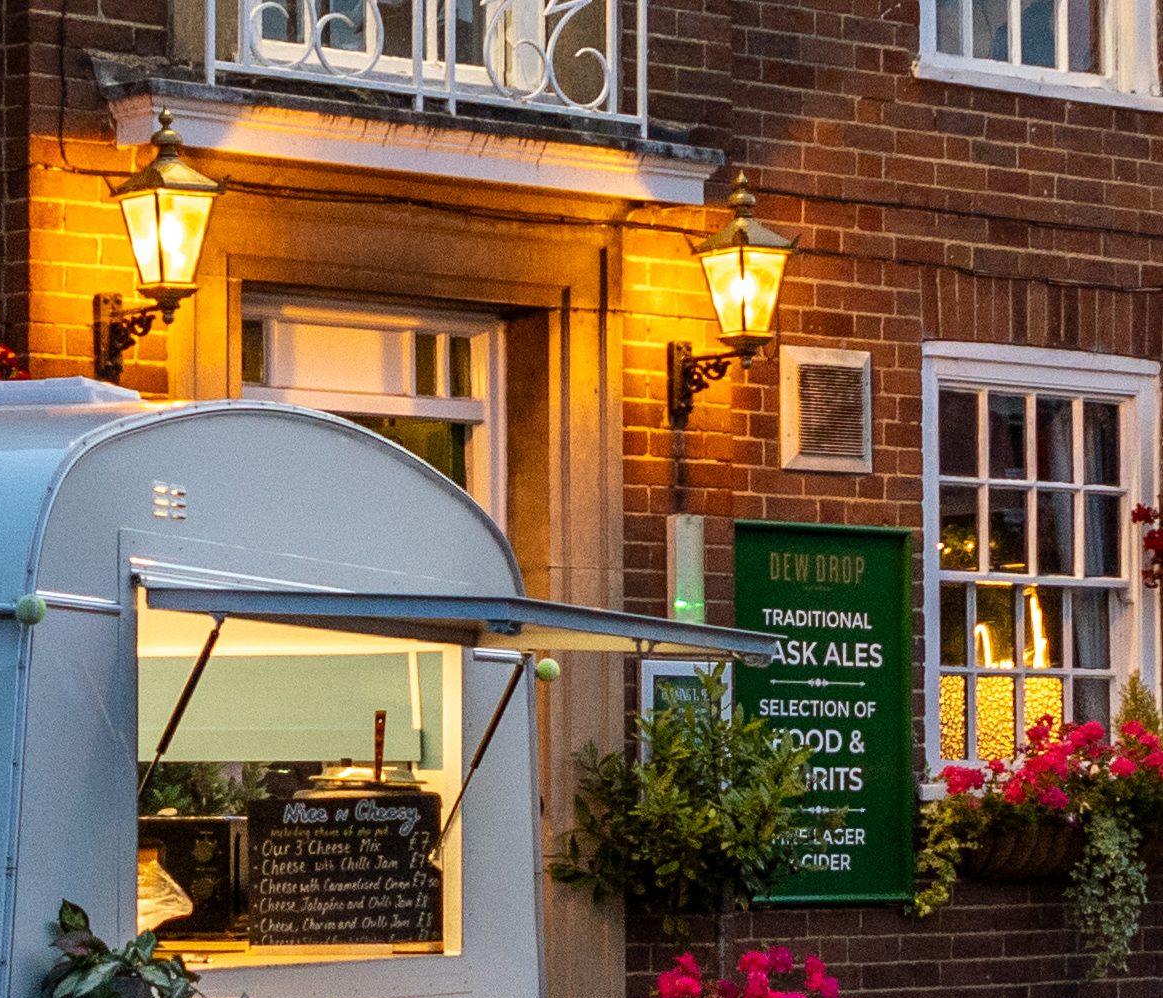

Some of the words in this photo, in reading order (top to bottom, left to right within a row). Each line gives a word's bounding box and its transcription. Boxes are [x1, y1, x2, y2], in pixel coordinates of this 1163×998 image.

[770, 552, 809, 581] DEW
[816, 554, 866, 584] DROP
[762, 608, 873, 630] TRADITIONAL
[771, 640, 817, 665] ASK
[823, 641, 884, 668] ALES
[759, 698, 850, 718] SELECTION
[854, 701, 876, 718] OF
[849, 730, 865, 754] &
[805, 766, 863, 791] RITS
[283, 802, 328, 824] Nice
[355, 799, 421, 837] Cheesy
[262, 840, 289, 857] Our
[296, 840, 302, 855] 3
[308, 840, 351, 855] Cheese
[359, 839, 381, 852] Mix
[409, 832, 430, 850] £7
[261, 859, 306, 876] Cheese
[315, 860, 334, 871] with
[374, 855, 398, 870] Jam
[801, 854, 851, 871] CIDER
[260, 879, 298, 895] Cheese
[299, 878, 320, 892] with
[347, 896, 364, 909] and
[394, 894, 413, 908] Jam
[338, 917, 358, 930] and
[390, 914, 410, 928] Jam
